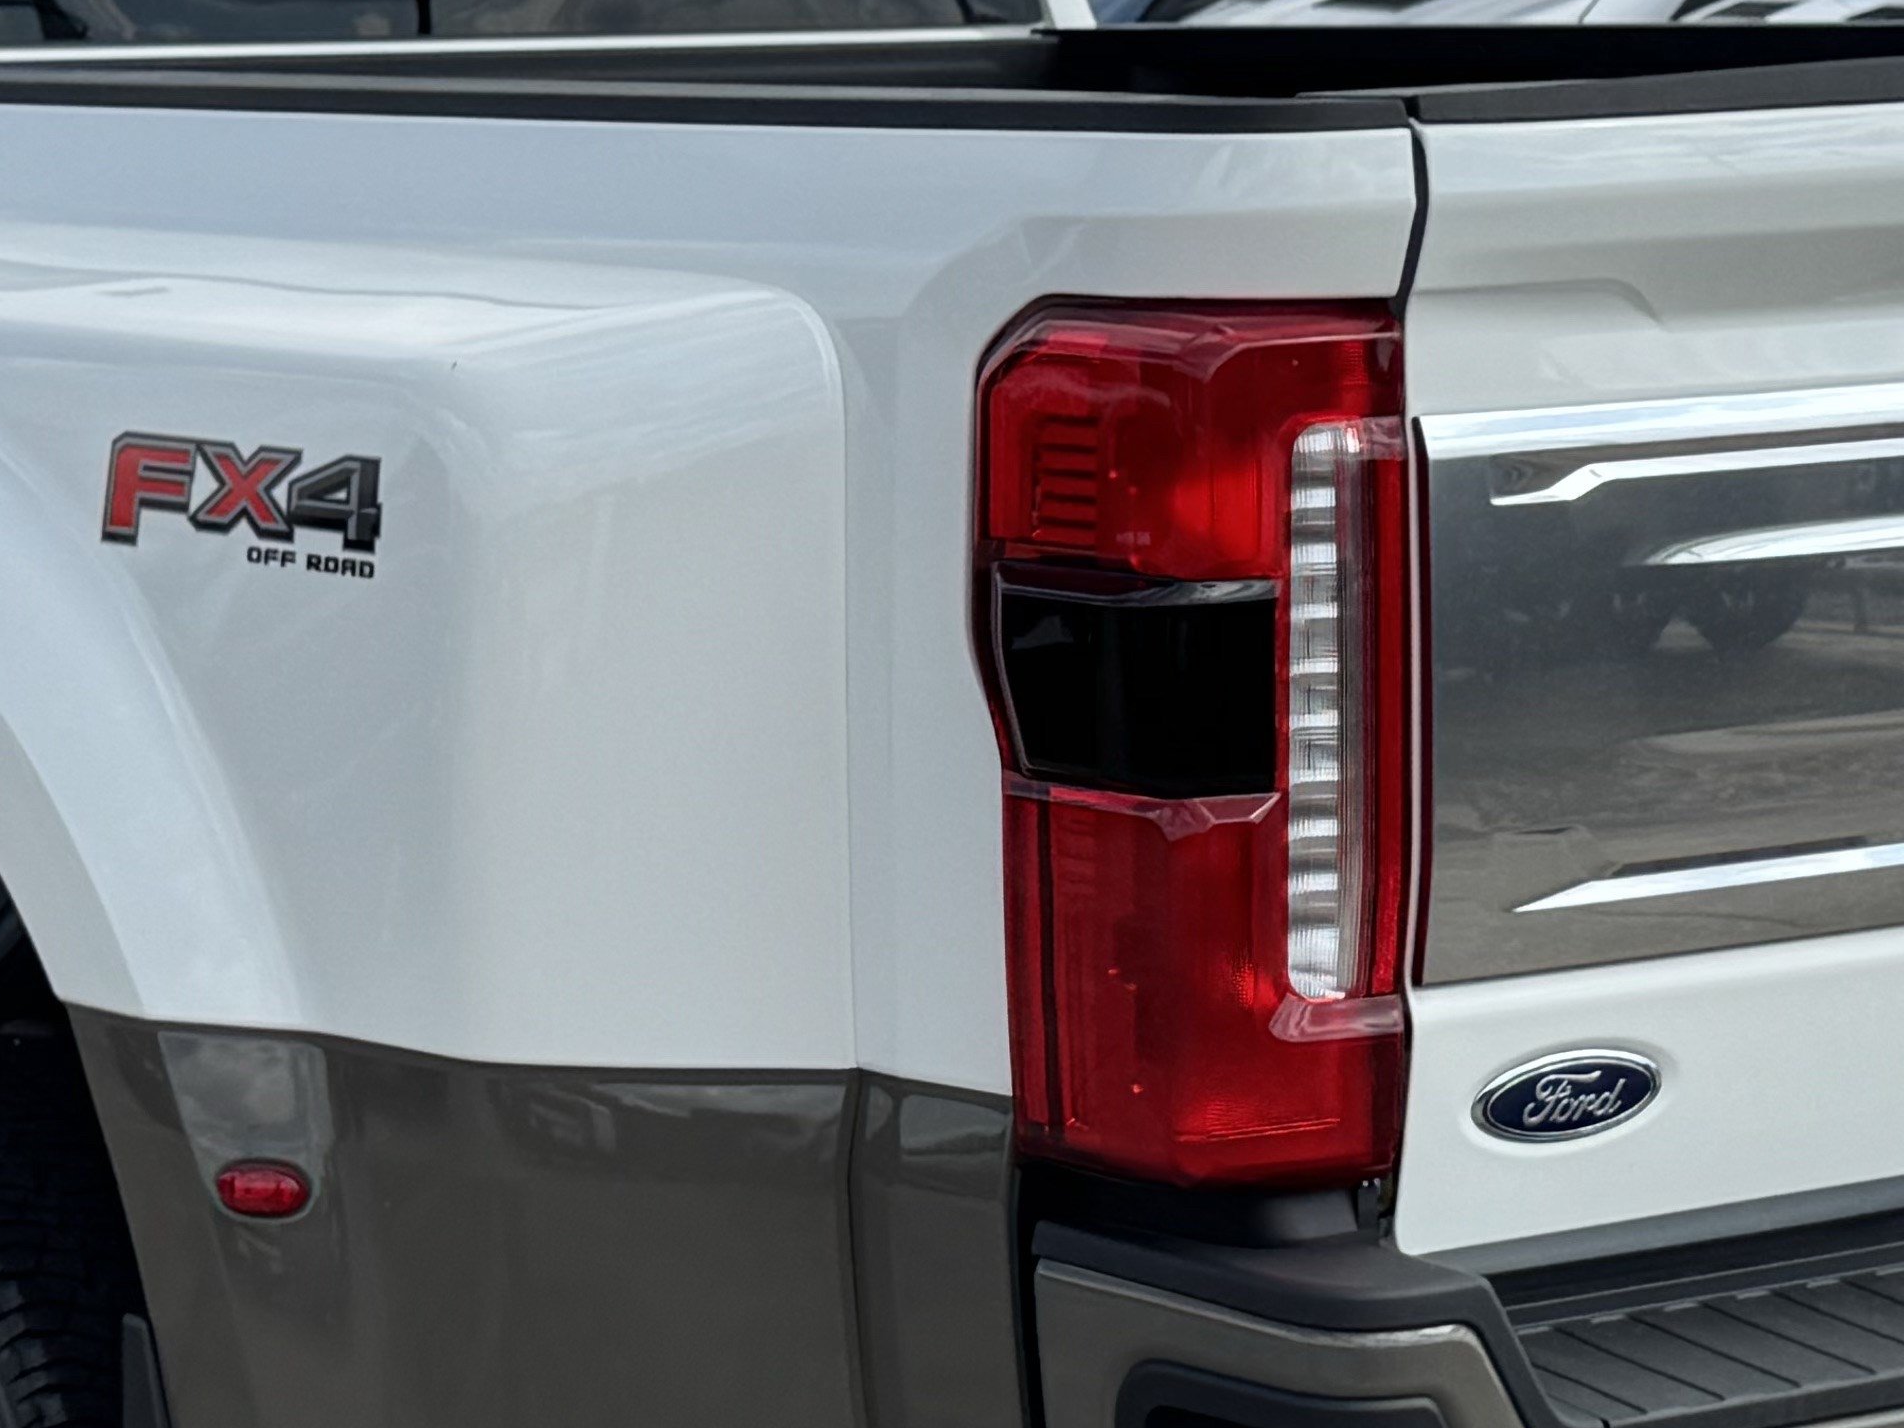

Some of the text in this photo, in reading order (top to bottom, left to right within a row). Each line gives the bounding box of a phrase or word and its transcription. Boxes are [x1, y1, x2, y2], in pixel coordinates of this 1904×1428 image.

[101, 431, 382, 553] FX4
[246, 546, 376, 579] OFF ROAD
[1523, 1070, 1626, 1126] Ford
